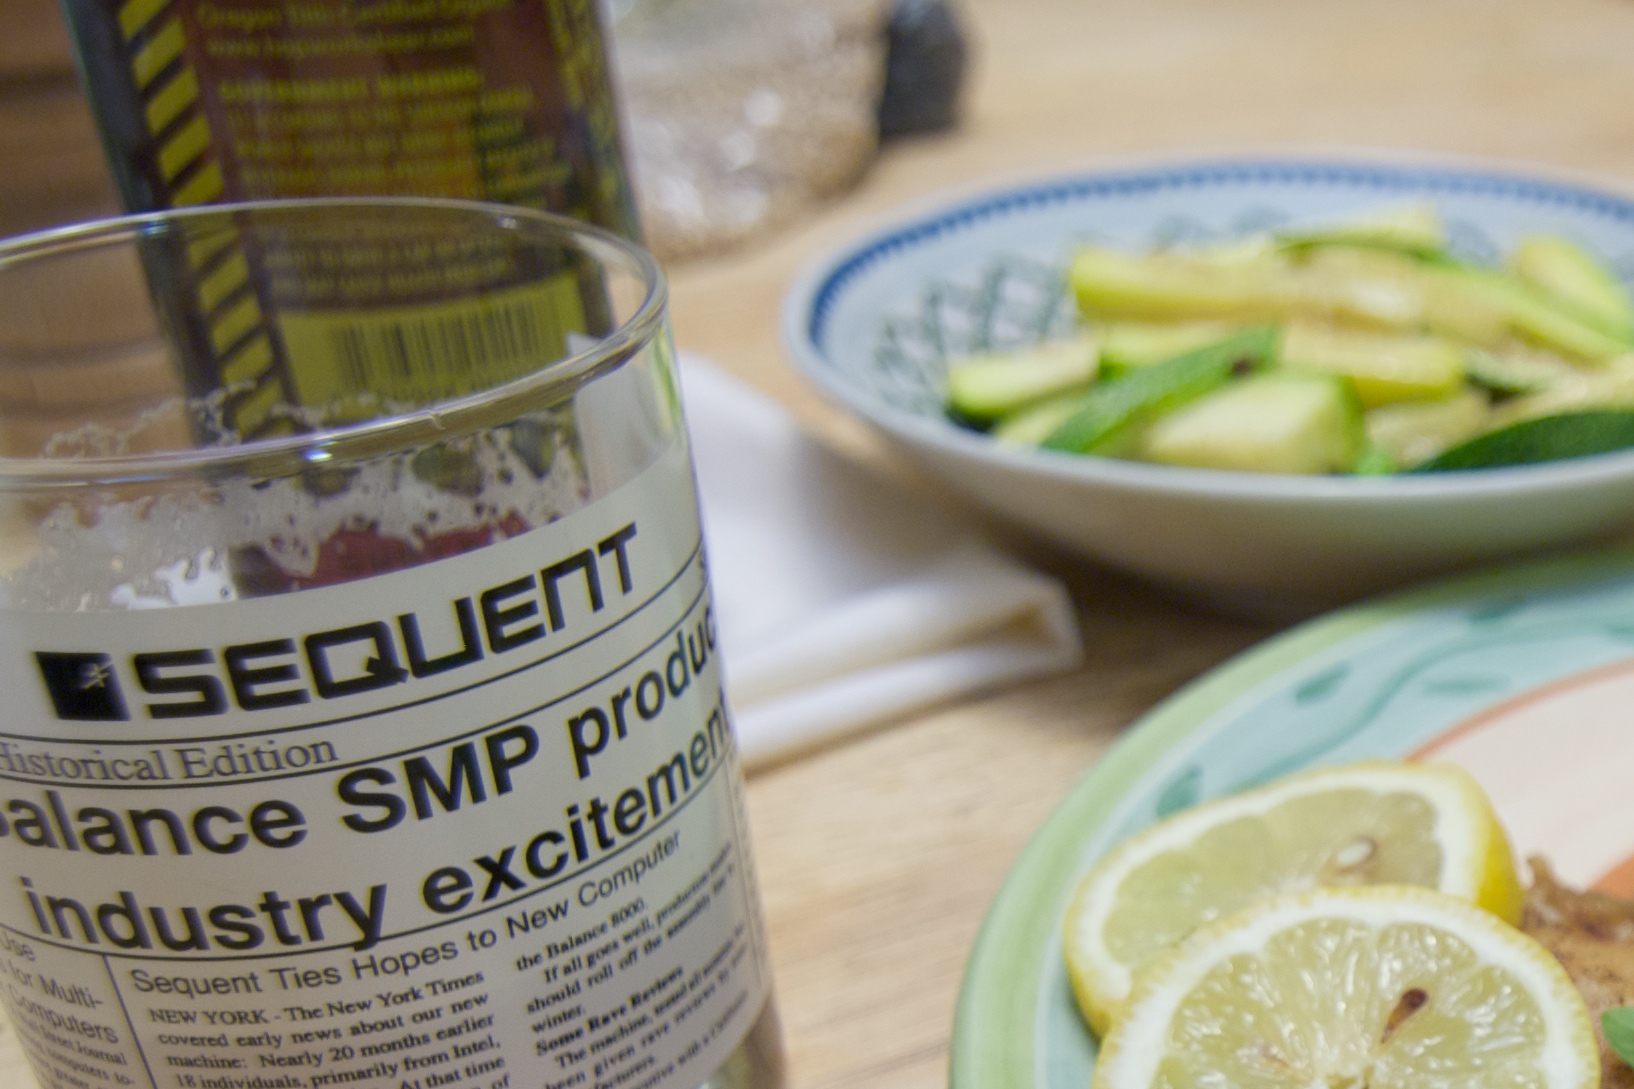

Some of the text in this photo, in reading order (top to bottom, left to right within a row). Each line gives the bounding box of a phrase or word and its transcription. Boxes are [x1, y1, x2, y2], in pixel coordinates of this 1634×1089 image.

[132, 522, 638, 720] SEQUENT
[174, 736, 339, 779] Edition
[0, 790, 308, 855] alance
[337, 724, 539, 833] SMP
[20, 876, 387, 951] industry
[130, 969, 262, 999] Sequent
[268, 965, 343, 990] Ties
[352, 941, 458, 980] Hopes
[466, 929, 497, 952] to
[507, 899, 569, 939] New
[578, 831, 681, 907] Computer
[515, 948, 544, 972] the
[546, 920, 608, 960] Balance
[541, 966, 559, 985] If
[562, 956, 583, 978] all
[586, 940, 620, 968] goes
[39, 972, 103, 1008] Multi-
[149, 1009, 197, 1024] NEW
[203, 1009, 270, 1026] YORK
[284, 1007, 324, 1022] The
[327, 998, 372, 1018] New
[376, 987, 424, 1009] York
[425, 971, 484, 996] Times
[526, 980, 581, 1014] should
[586, 964, 614, 987] roll
[618, 947, 639, 971] off
[642, 934, 663, 956] the
[9, 983, 119, 1043] Computers
[158, 993, 489, 1049] covered early news about our new
[532, 1004, 587, 1034] winter.
[534, 965, 685, 1058] Some Rave Reviews
[167, 1014, 495, 1069] machine: Nearly 20 months earlier
[177, 1035, 502, 1089] 18 individuals, primarily from Intel,
[554, 1046, 587, 1070] The
[590, 1014, 654, 1055] machine,
[593, 1045, 635, 1077] given
[640, 1022, 670, 1048] rave
[426, 1070, 461, 1089] that
[465, 1057, 506, 1078] time
